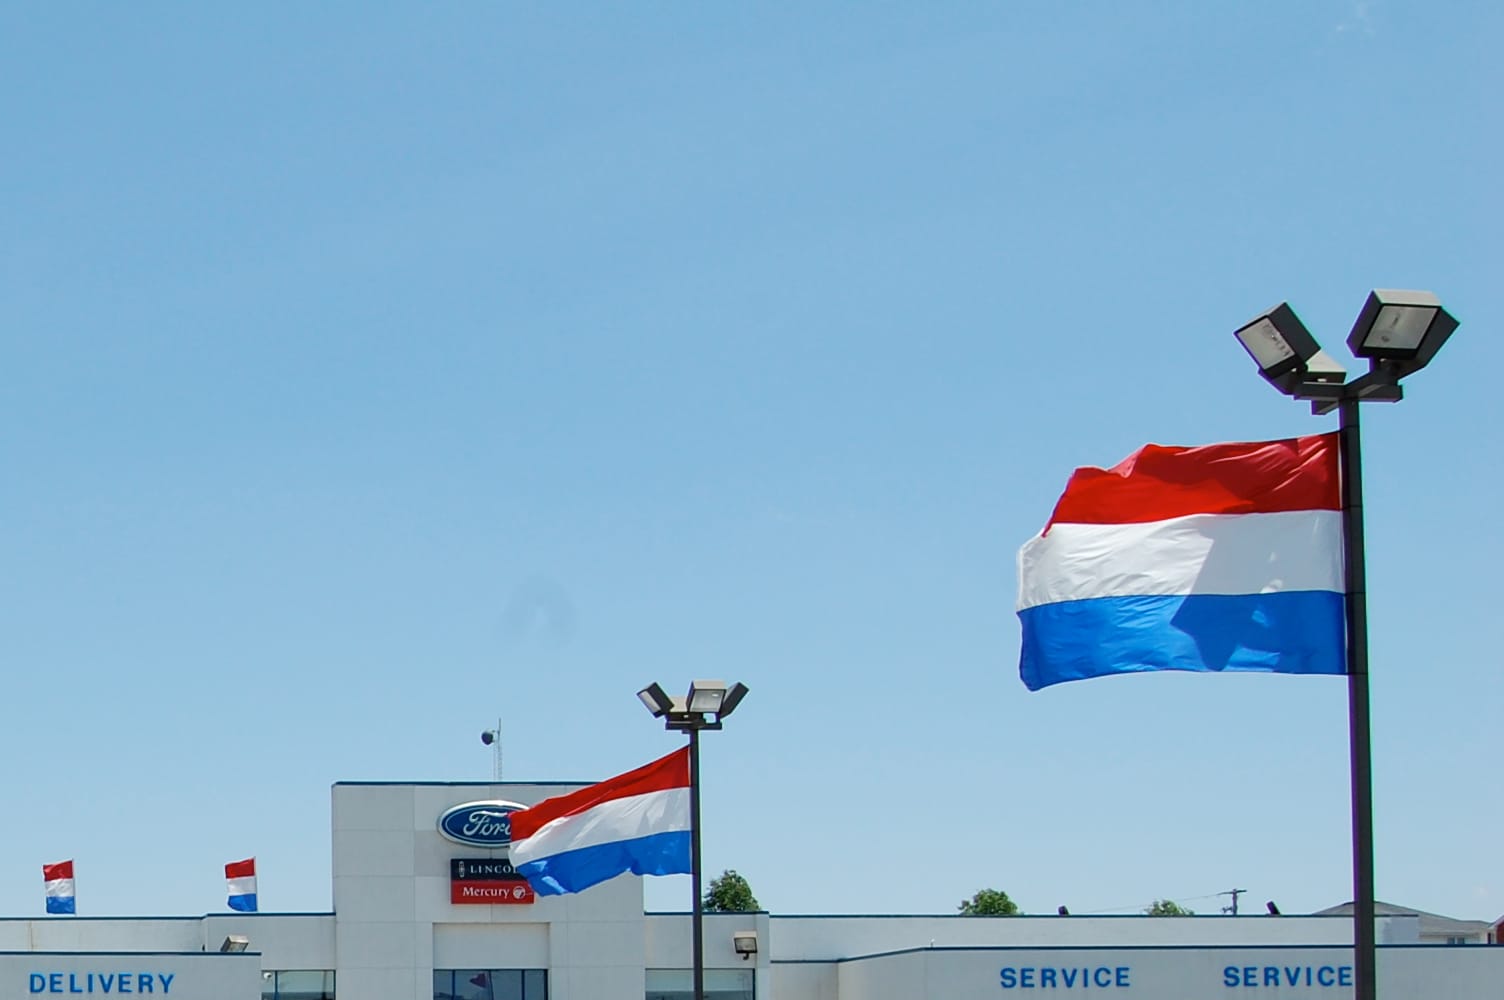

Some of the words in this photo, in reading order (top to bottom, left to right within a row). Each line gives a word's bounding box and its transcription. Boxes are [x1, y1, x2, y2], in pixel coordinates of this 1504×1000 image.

[470, 865, 521, 874] LINCOL
[462, 886, 510, 899] Mercury
[29, 973, 175, 994] DELIVERY
[999, 966, 1131, 989] SERVICE
[1222, 965, 1353, 988] SERVICE
